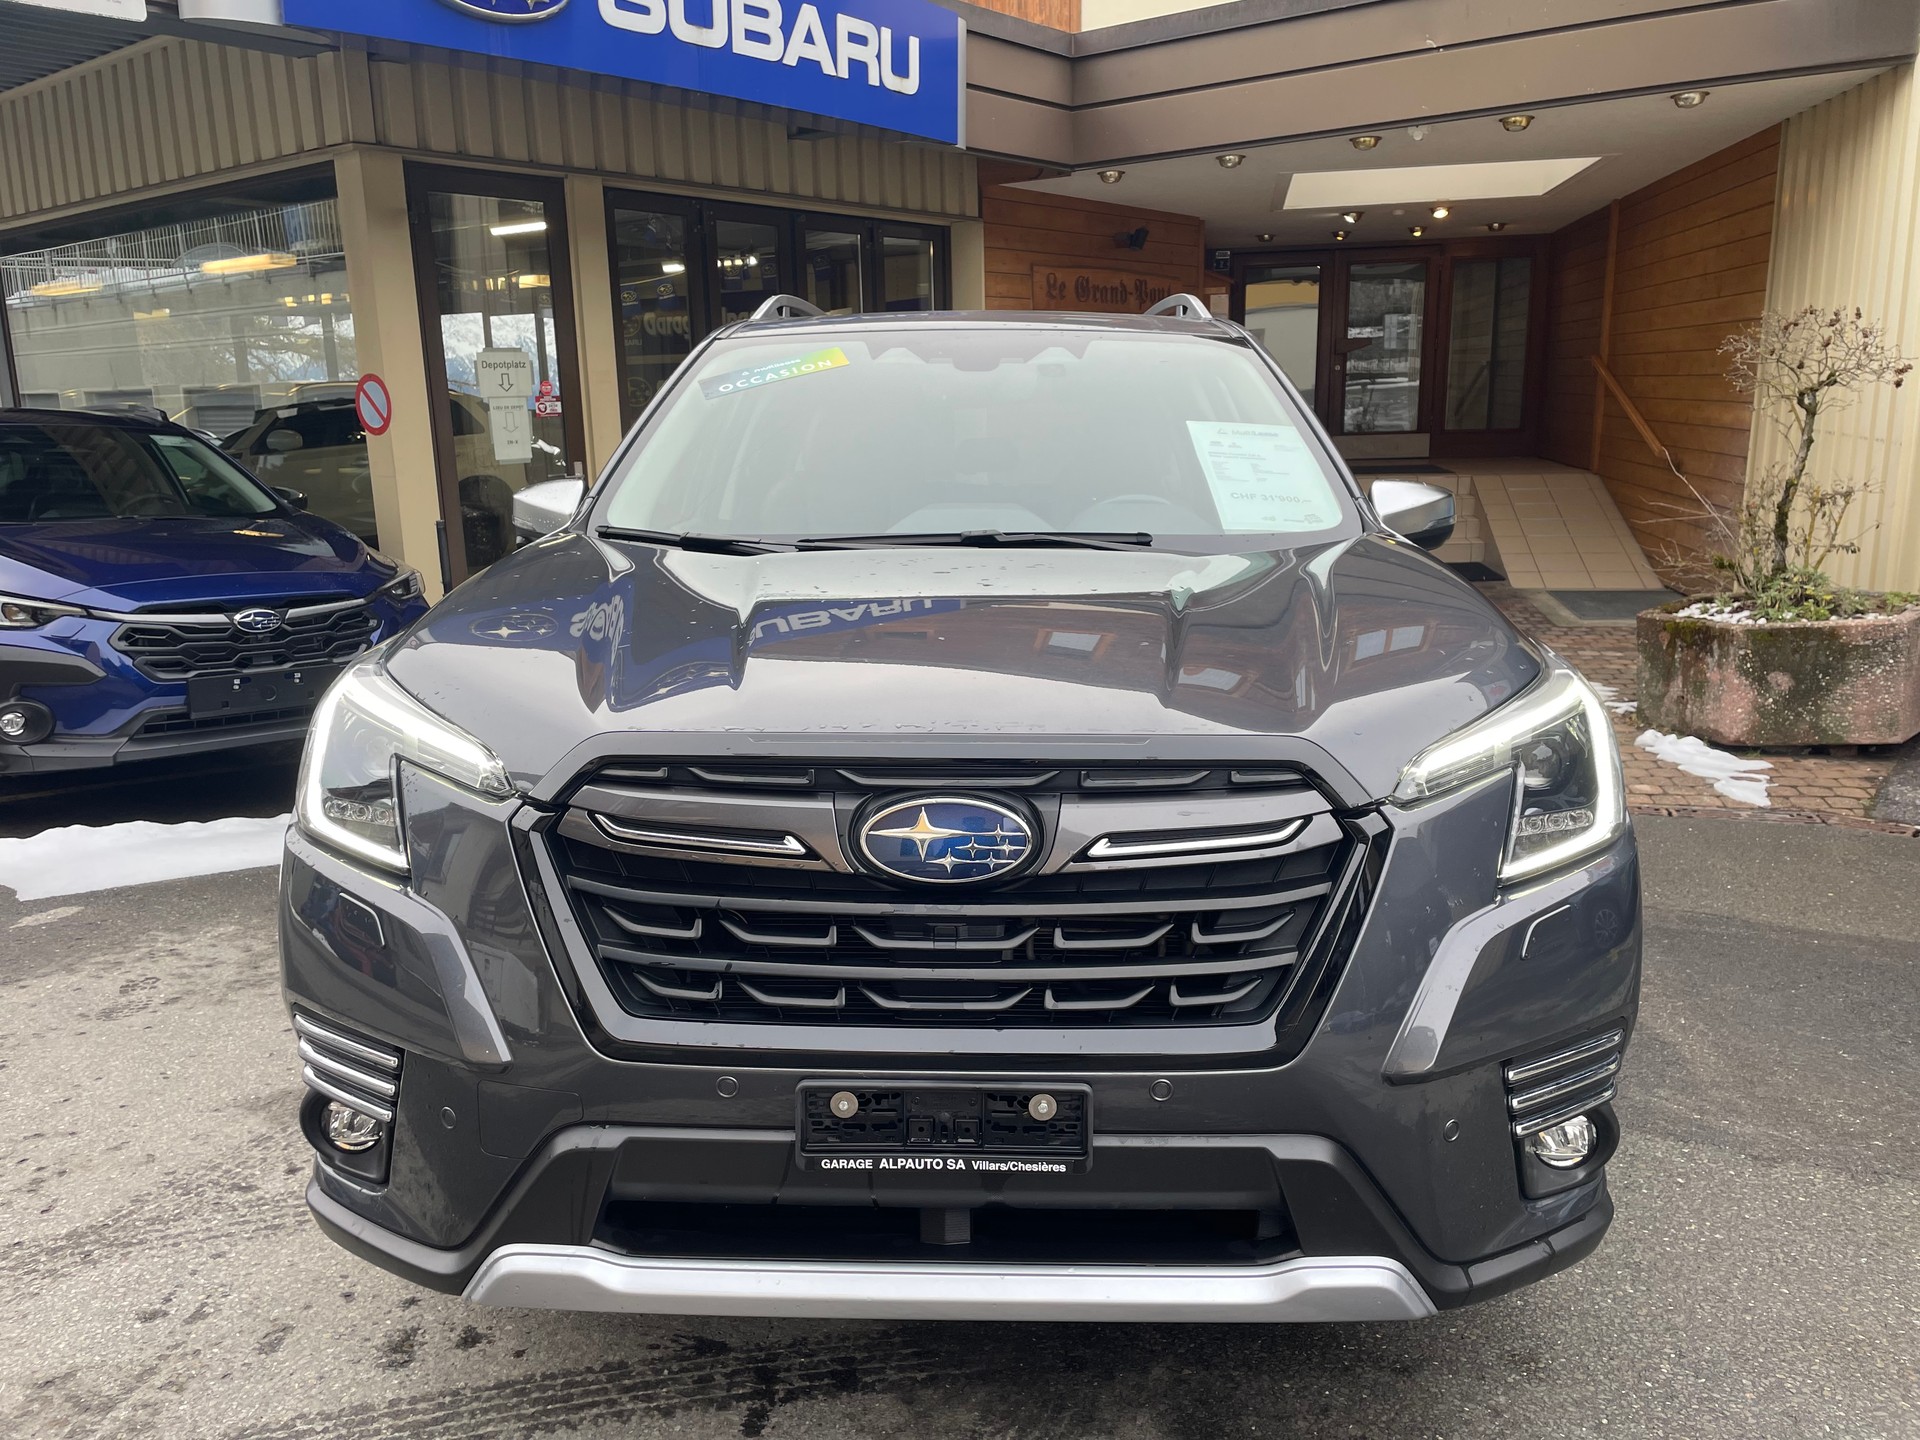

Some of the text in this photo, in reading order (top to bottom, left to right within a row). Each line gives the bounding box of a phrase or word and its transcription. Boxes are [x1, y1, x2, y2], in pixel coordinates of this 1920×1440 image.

[1046, 272, 1066, 300] Le
[481, 360, 527, 371] Depotplatz
[718, 359, 832, 392] OCCASION
[1230, 492, 1257, 500] CHF
[821, 1158, 1067, 1173] GARAGE ALPAUTO SA Villars/Chesières
